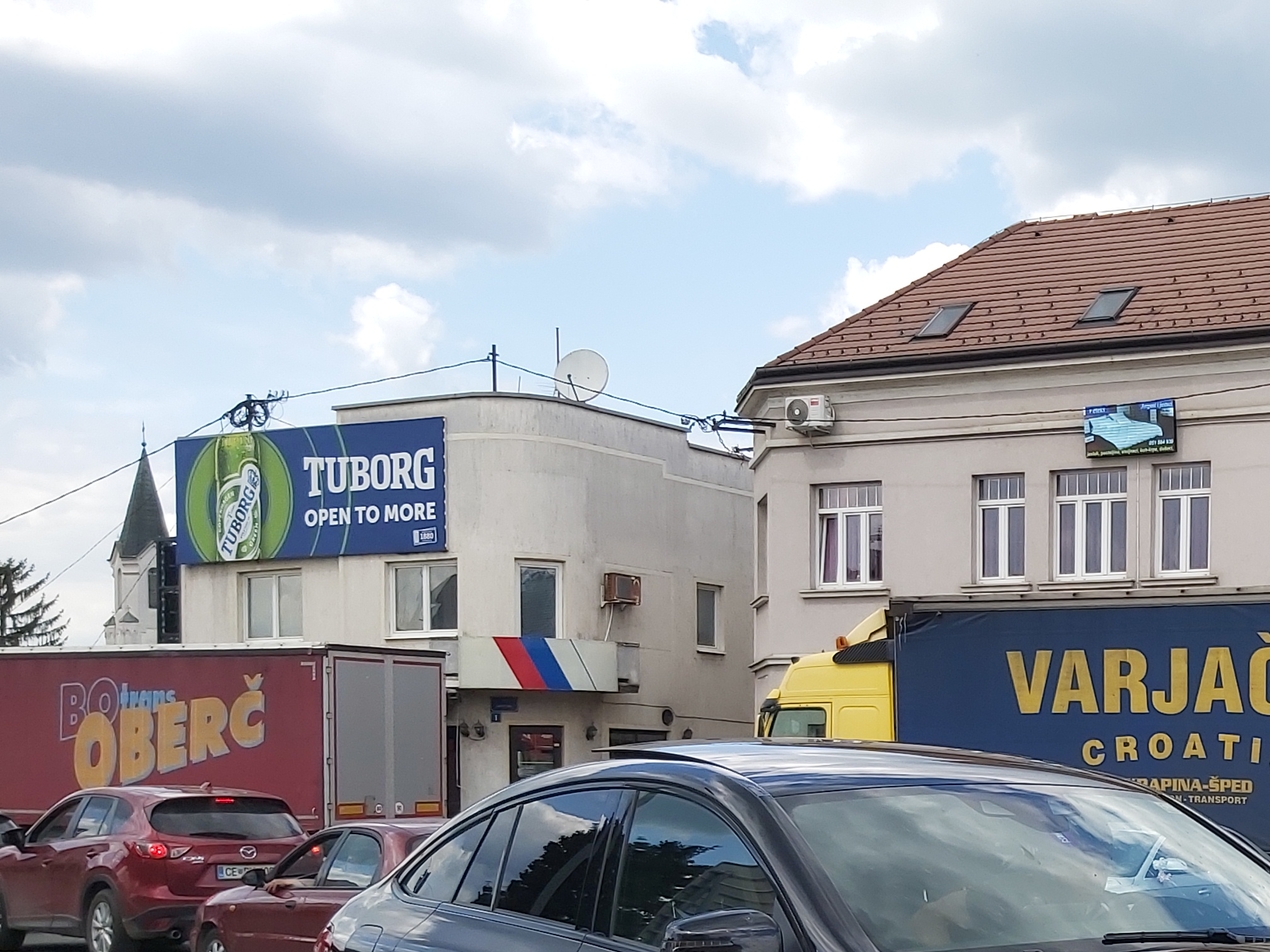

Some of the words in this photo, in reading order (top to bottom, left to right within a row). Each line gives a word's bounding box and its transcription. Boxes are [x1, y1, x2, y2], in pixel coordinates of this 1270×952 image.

[303, 447, 436, 498] TUBORG
[221, 486, 255, 557] TUBORG
[304, 508, 351, 527] OPEN
[354, 505, 380, 524] TO
[384, 502, 437, 522] MORE
[74, 673, 265, 790] OBERČ
[1132, 776, 1253, 794] RAPINA-ŠPED
